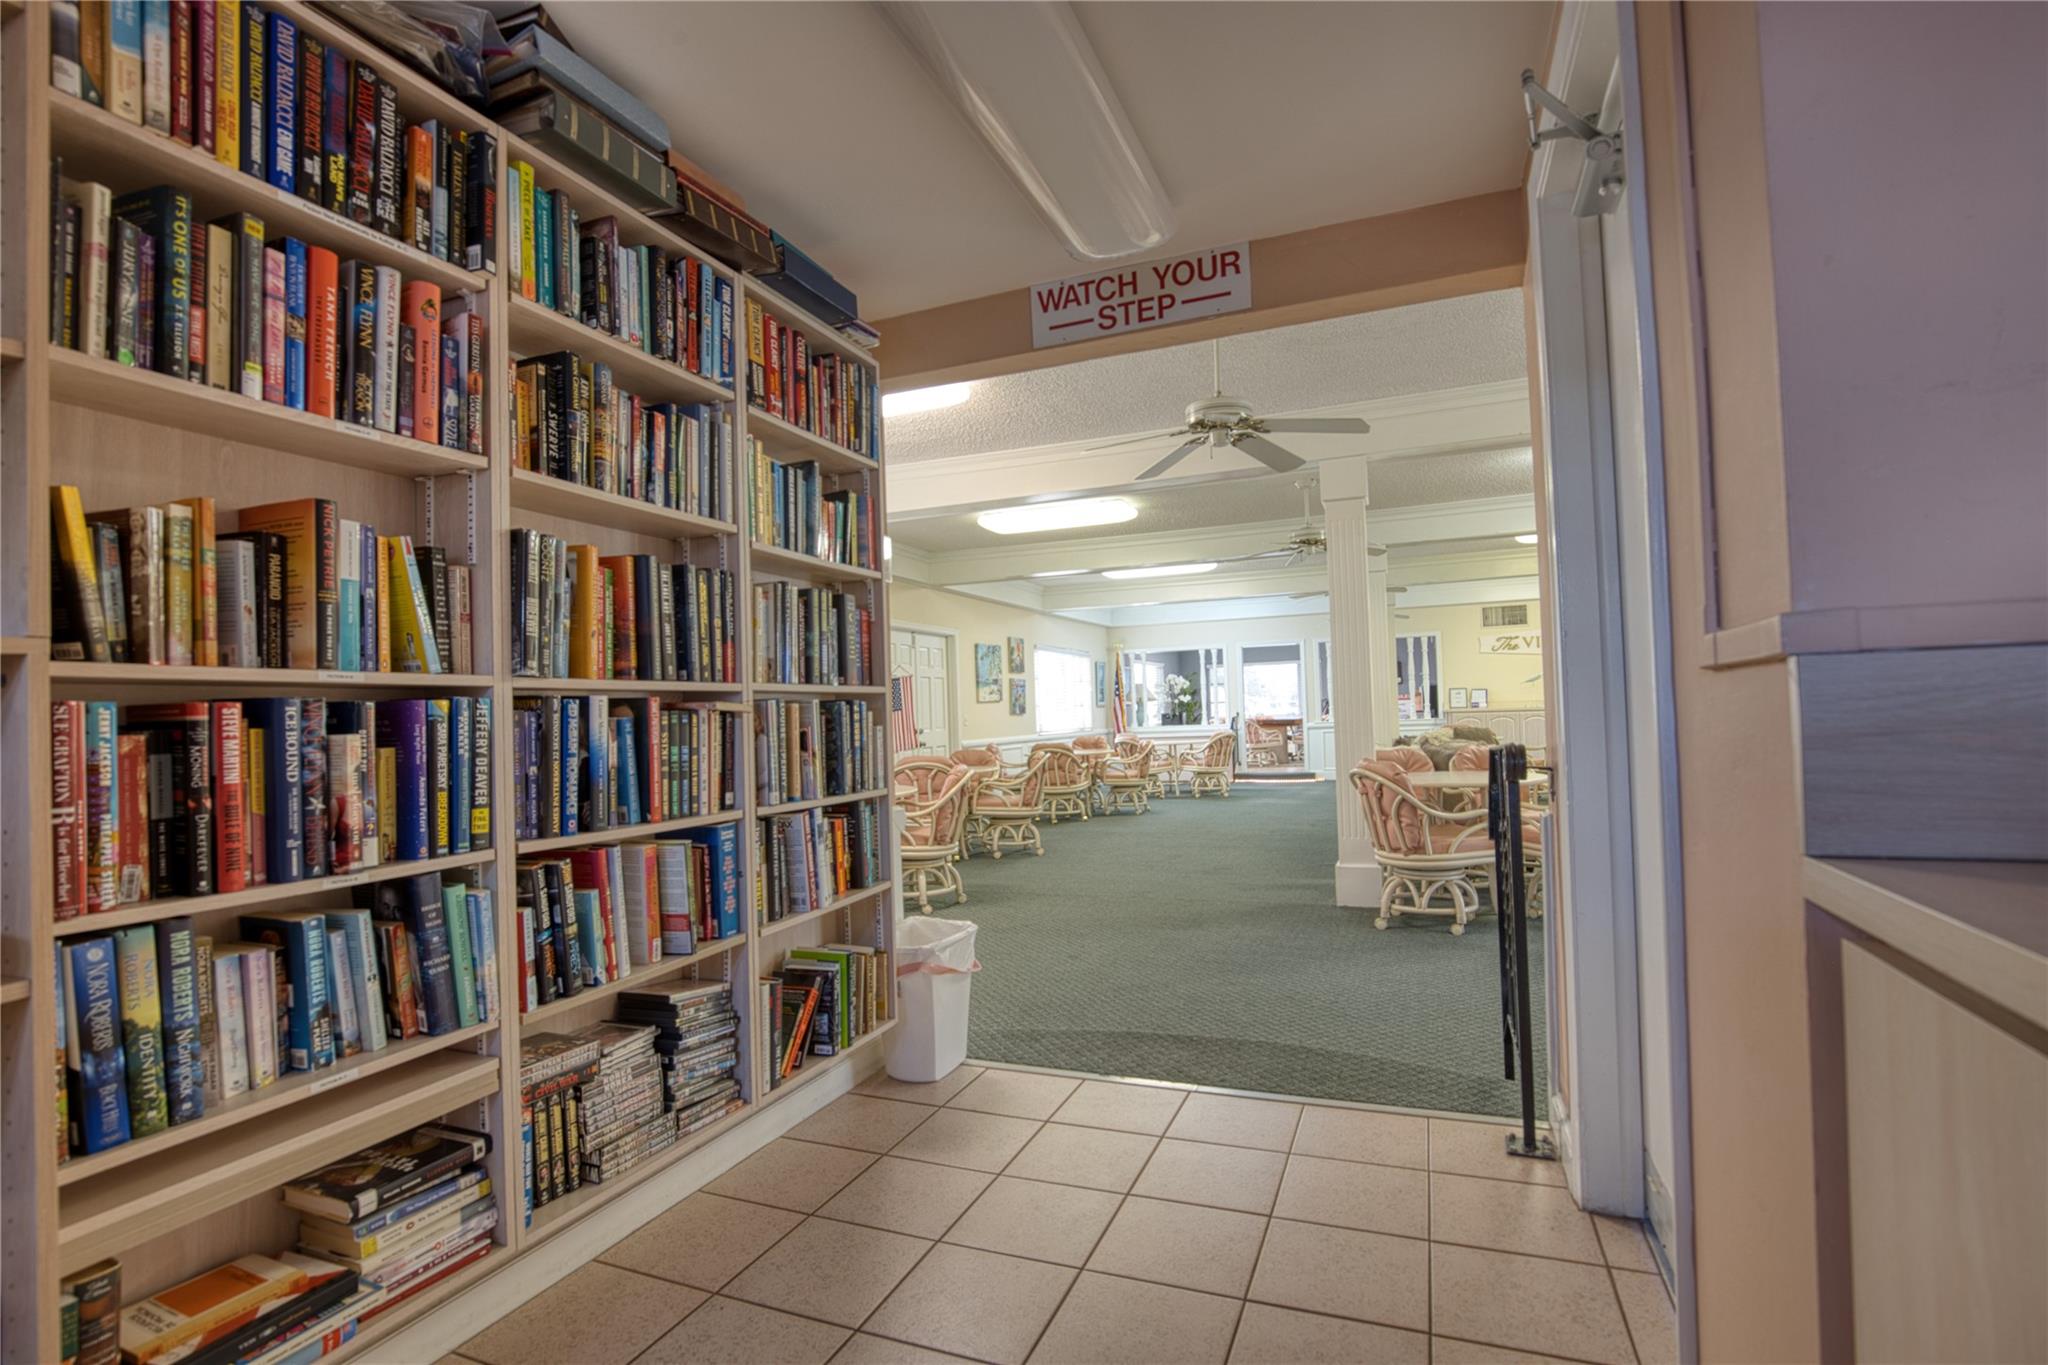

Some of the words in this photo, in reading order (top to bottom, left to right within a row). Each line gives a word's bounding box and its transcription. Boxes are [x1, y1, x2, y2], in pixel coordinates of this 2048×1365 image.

[250, 20, 262, 54] DAVID
[277, 20, 295, 63] DAVID
[250, 51, 263, 103] BALDACCI
[305, 52, 321, 92] DAVID
[276, 61, 295, 130] BALDACCI
[358, 80, 374, 121] DAVID
[304, 90, 321, 151] BALDACCI
[380, 97, 396, 137] DAVID
[277, 146, 293, 177] GAME
[337, 153, 344, 170] NO
[353, 119, 371, 193] BALDACCI
[380, 132, 396, 194] BALDACCI
[176, 196, 188, 219] IT'S
[173, 221, 190, 255] ONE
[121, 240, 136, 281] JURY
[175, 252, 186, 276] OF
[249, 257, 260, 285] HAVE
[172, 278, 188, 302] US
[250, 290, 260, 309] WE
[360, 268, 374, 305] VINCE
[387, 273, 398, 304] VINCE
[721, 284, 732, 306] TOM
[1037, 271, 1138, 313] WATCH
[1152, 250, 1242, 290] YOUR
[325, 286, 335, 322] TANA
[386, 303, 397, 338] FLYNN
[721, 303, 732, 341] CLANCY
[1097, 293, 1177, 330] STEP
[174, 322, 184, 361] ELLISON
[250, 312, 261, 344] DONE
[359, 307, 374, 350] FLYNN
[471, 317, 481, 338] TESS
[769, 319, 780, 338] TOM
[324, 327, 335, 382] FRENCH
[421, 340, 430, 366] Bonnie
[470, 335, 482, 375] GERRITSEN
[770, 338, 780, 371] CLANCY
[421, 366, 429, 394] Garmus
[445, 418, 459, 450] SIZZLE
[548, 409, 560, 460] SWERVE
[323, 503, 336, 538] NICK
[269, 553, 282, 601] PARANOID
[323, 539, 336, 590] PETRIE
[270, 606, 279, 624] LISA
[326, 604, 334, 616] THE
[326, 616, 334, 635] PRICE
[270, 625, 280, 669] JACKSON
[326, 635, 334, 648] YOU
[1492, 636, 1520, 651] The
[52, 705, 70, 733] SUE
[98, 708, 113, 739] JENNY
[221, 707, 241, 738] STEVE
[284, 705, 299, 730] ICE
[436, 722, 449, 747] SARA
[457, 716, 466, 756] PARKER
[475, 703, 491, 754] JEFFERY
[53, 735, 71, 803] GRAFTON
[98, 740, 113, 788] JACKSON
[189, 745, 203, 789] MONING
[222, 738, 242, 785] MARTINI
[284, 730, 300, 783] BOUND
[436, 747, 449, 789] PARETSKY
[418, 775, 428, 806] Amanda
[474, 757, 490, 806] DEAVER
[552, 760, 561, 807] PATTERSON
[565, 757, 579, 816] ROMANCE
[49, 806, 76, 825] R
[224, 804, 239, 830] RULE
[418, 807, 428, 834] Peters
[436, 791, 449, 847] BREAKDOWN
[552, 806, 561, 834] JAMES
[99, 813, 114, 868] PINEAPPLE
[194, 813, 210, 873] DARKFEVER
[56, 855, 71, 903] Ricochet
[99, 870, 117, 911] STREET
[169, 930, 193, 967] NORA
[307, 929, 325, 959] NORA
[86, 961, 111, 1001] NORA
[172, 966, 195, 1023] ROBERTS
[309, 957, 328, 1006] ROBERTS
[84, 998, 114, 1053] ROBERTS
[312, 1027, 322, 1054] PLACE
[138, 1032, 160, 1101] IDENTITY
[173, 1026, 194, 1101] NIGHTWORK
